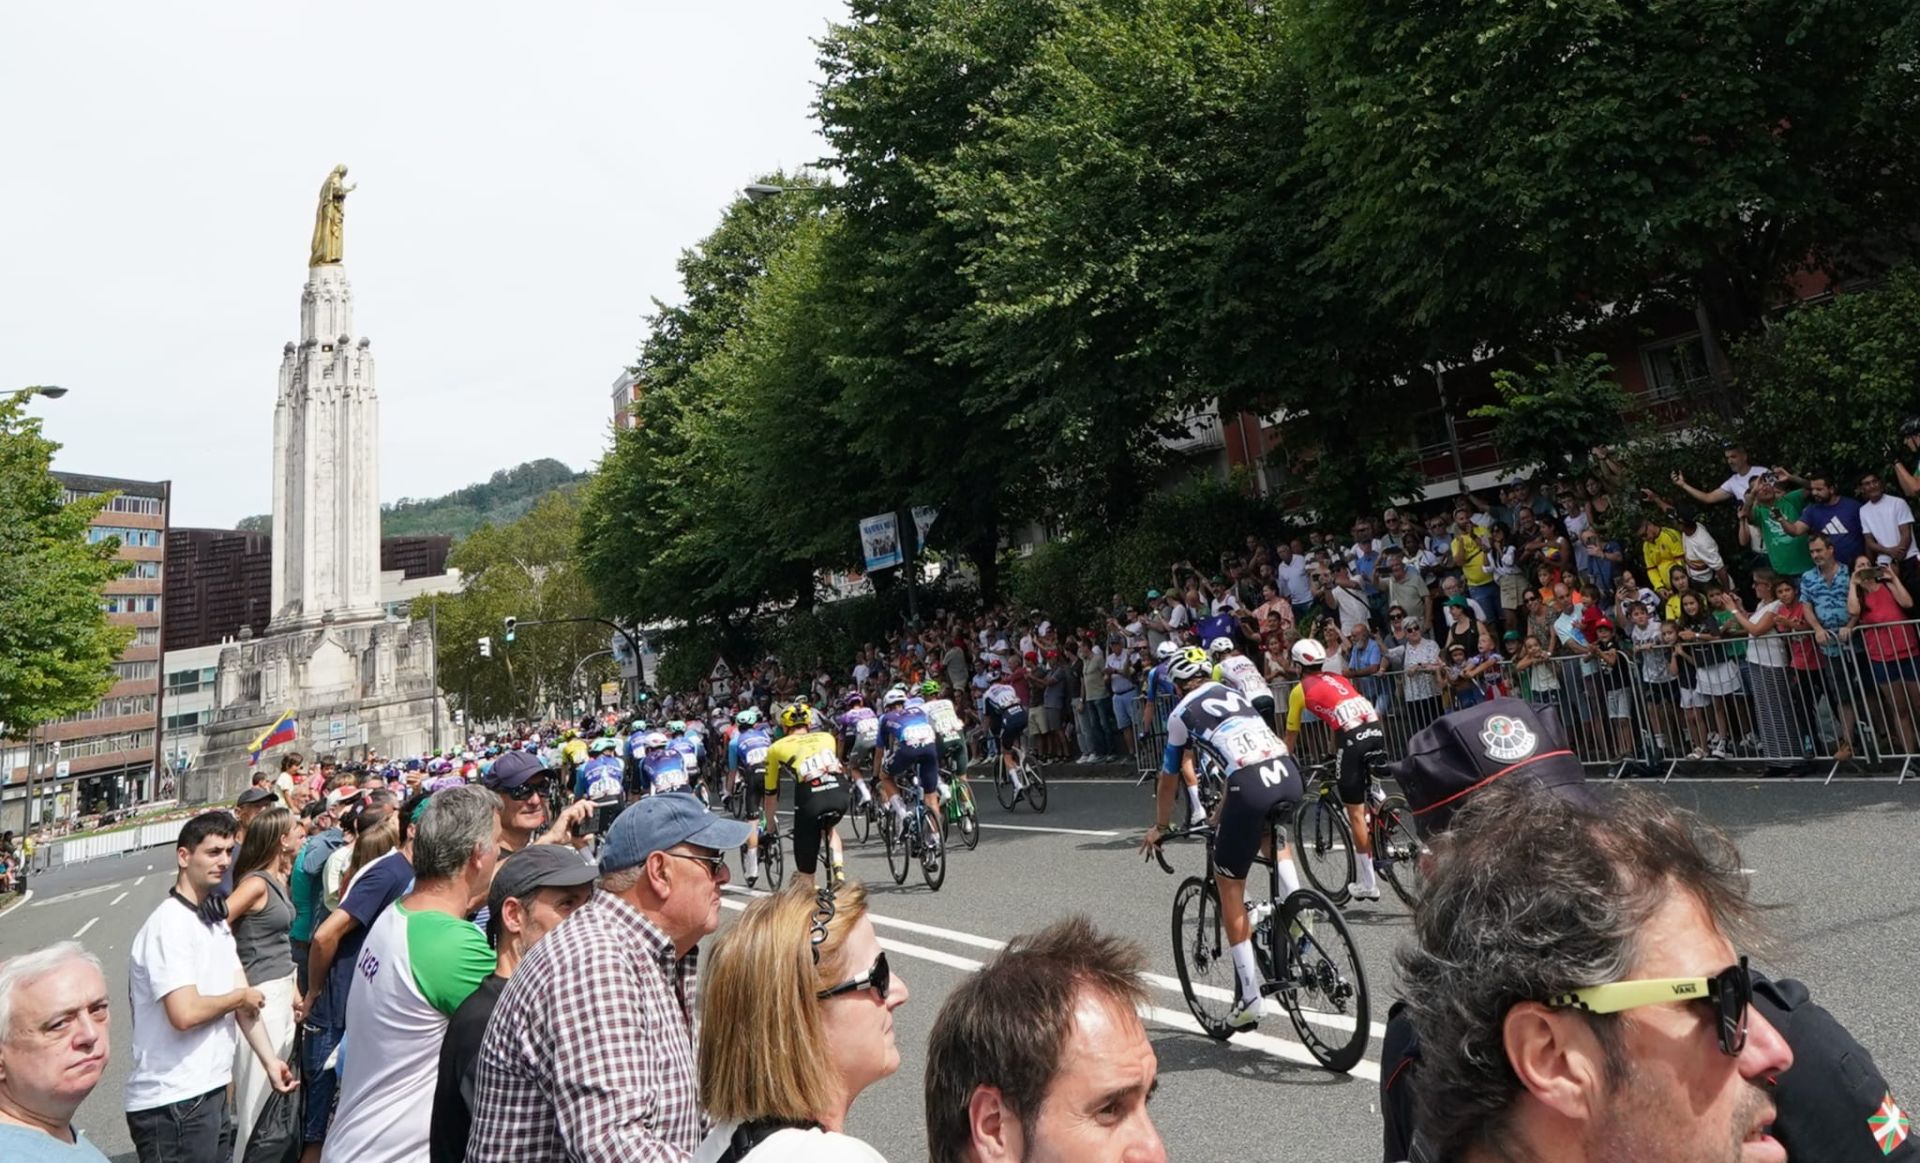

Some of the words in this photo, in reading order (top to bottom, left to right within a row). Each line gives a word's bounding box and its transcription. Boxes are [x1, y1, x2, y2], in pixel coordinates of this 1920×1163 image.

[1233, 731, 1257, 755] 36
[805, 757, 818, 772] 14
[1671, 983, 1697, 995] VANS
